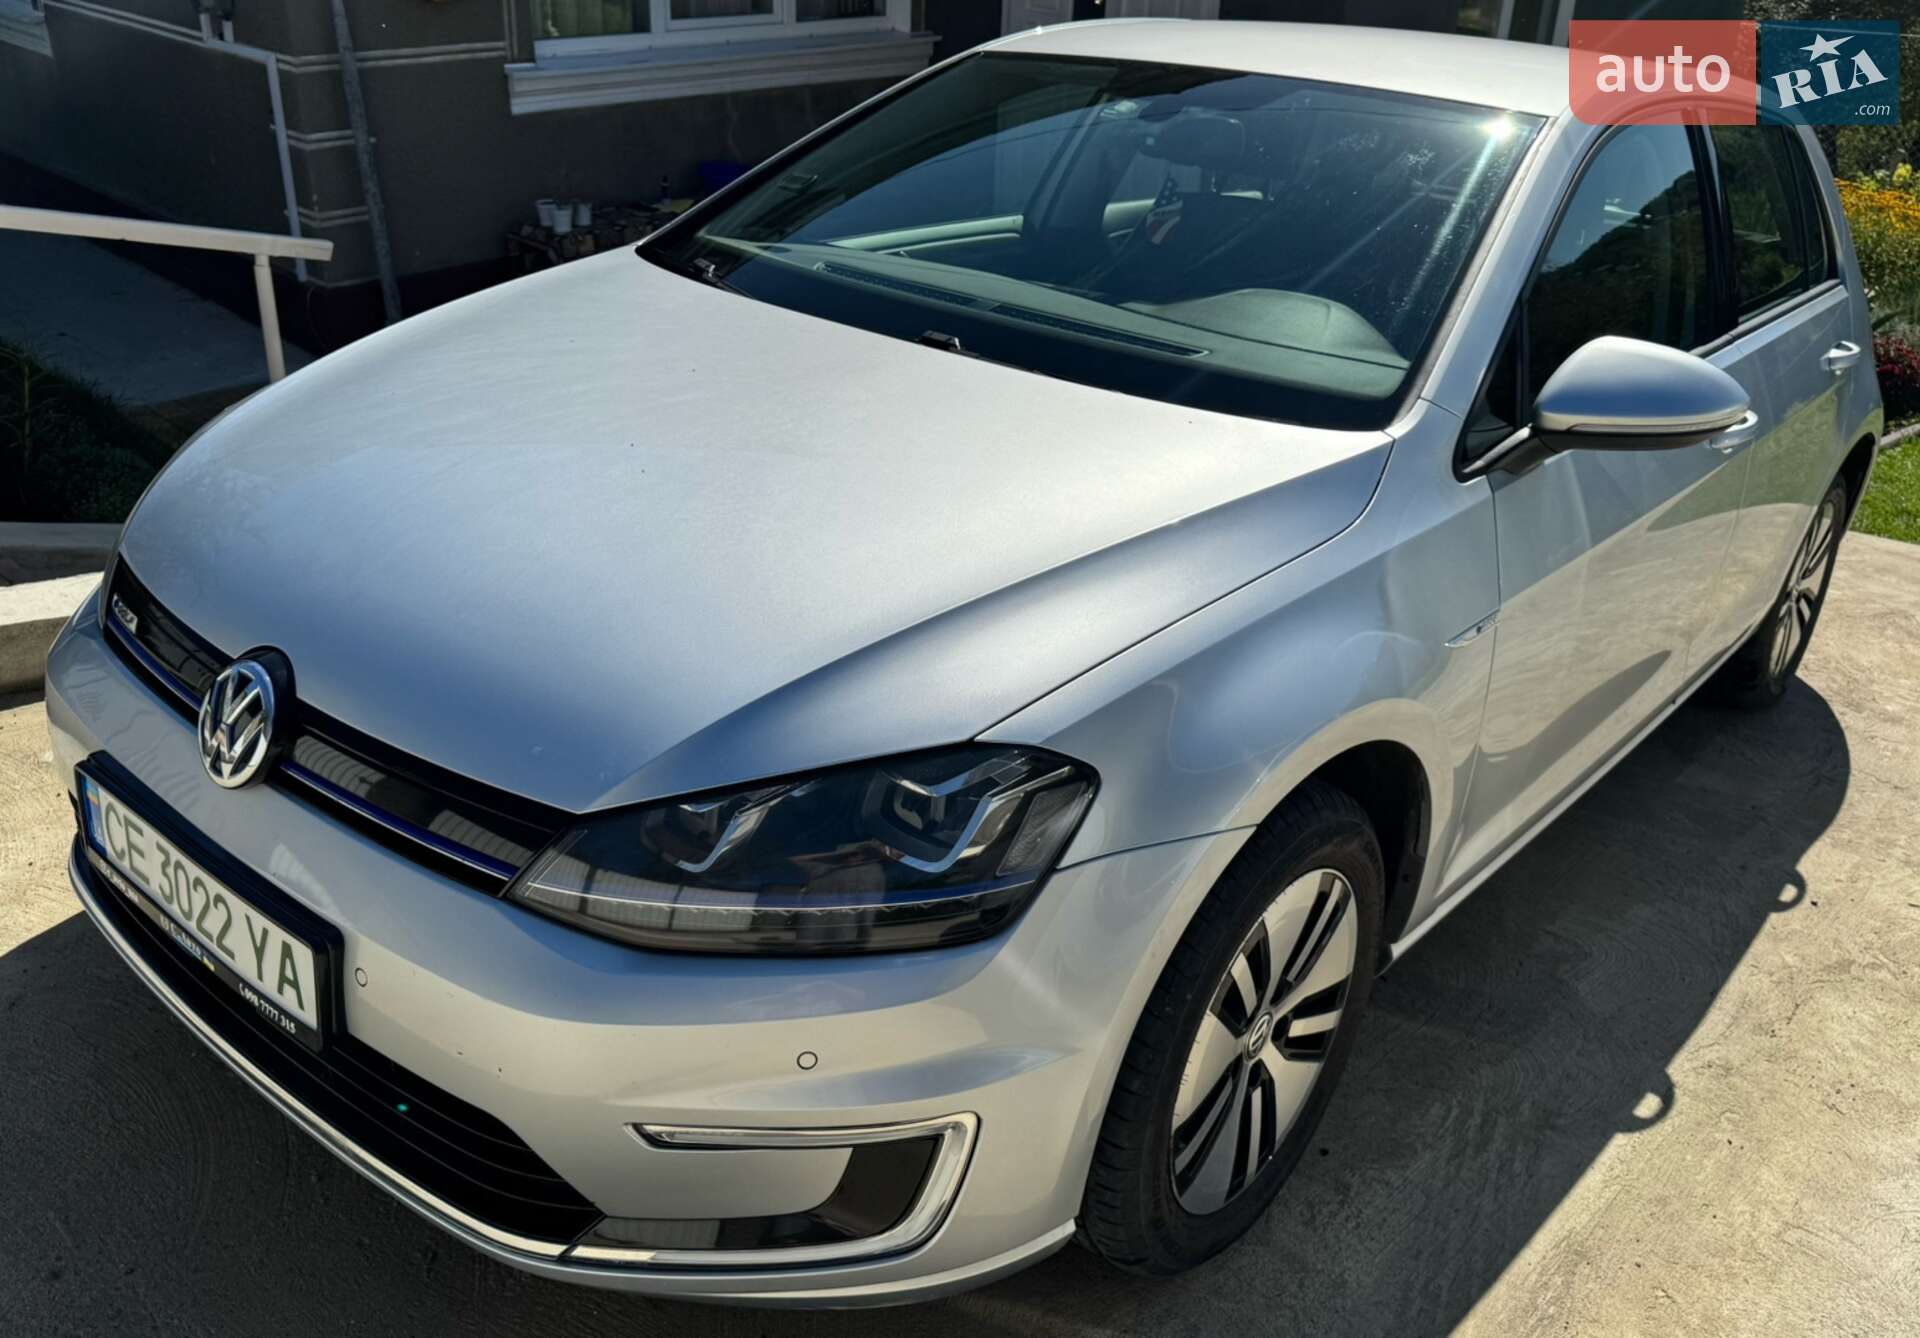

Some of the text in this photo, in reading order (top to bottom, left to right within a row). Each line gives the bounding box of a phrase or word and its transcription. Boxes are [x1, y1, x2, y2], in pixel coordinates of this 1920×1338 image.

[104, 801, 150, 885] CE
[156, 841, 236, 961] 3022
[244, 912, 305, 1012] YA
